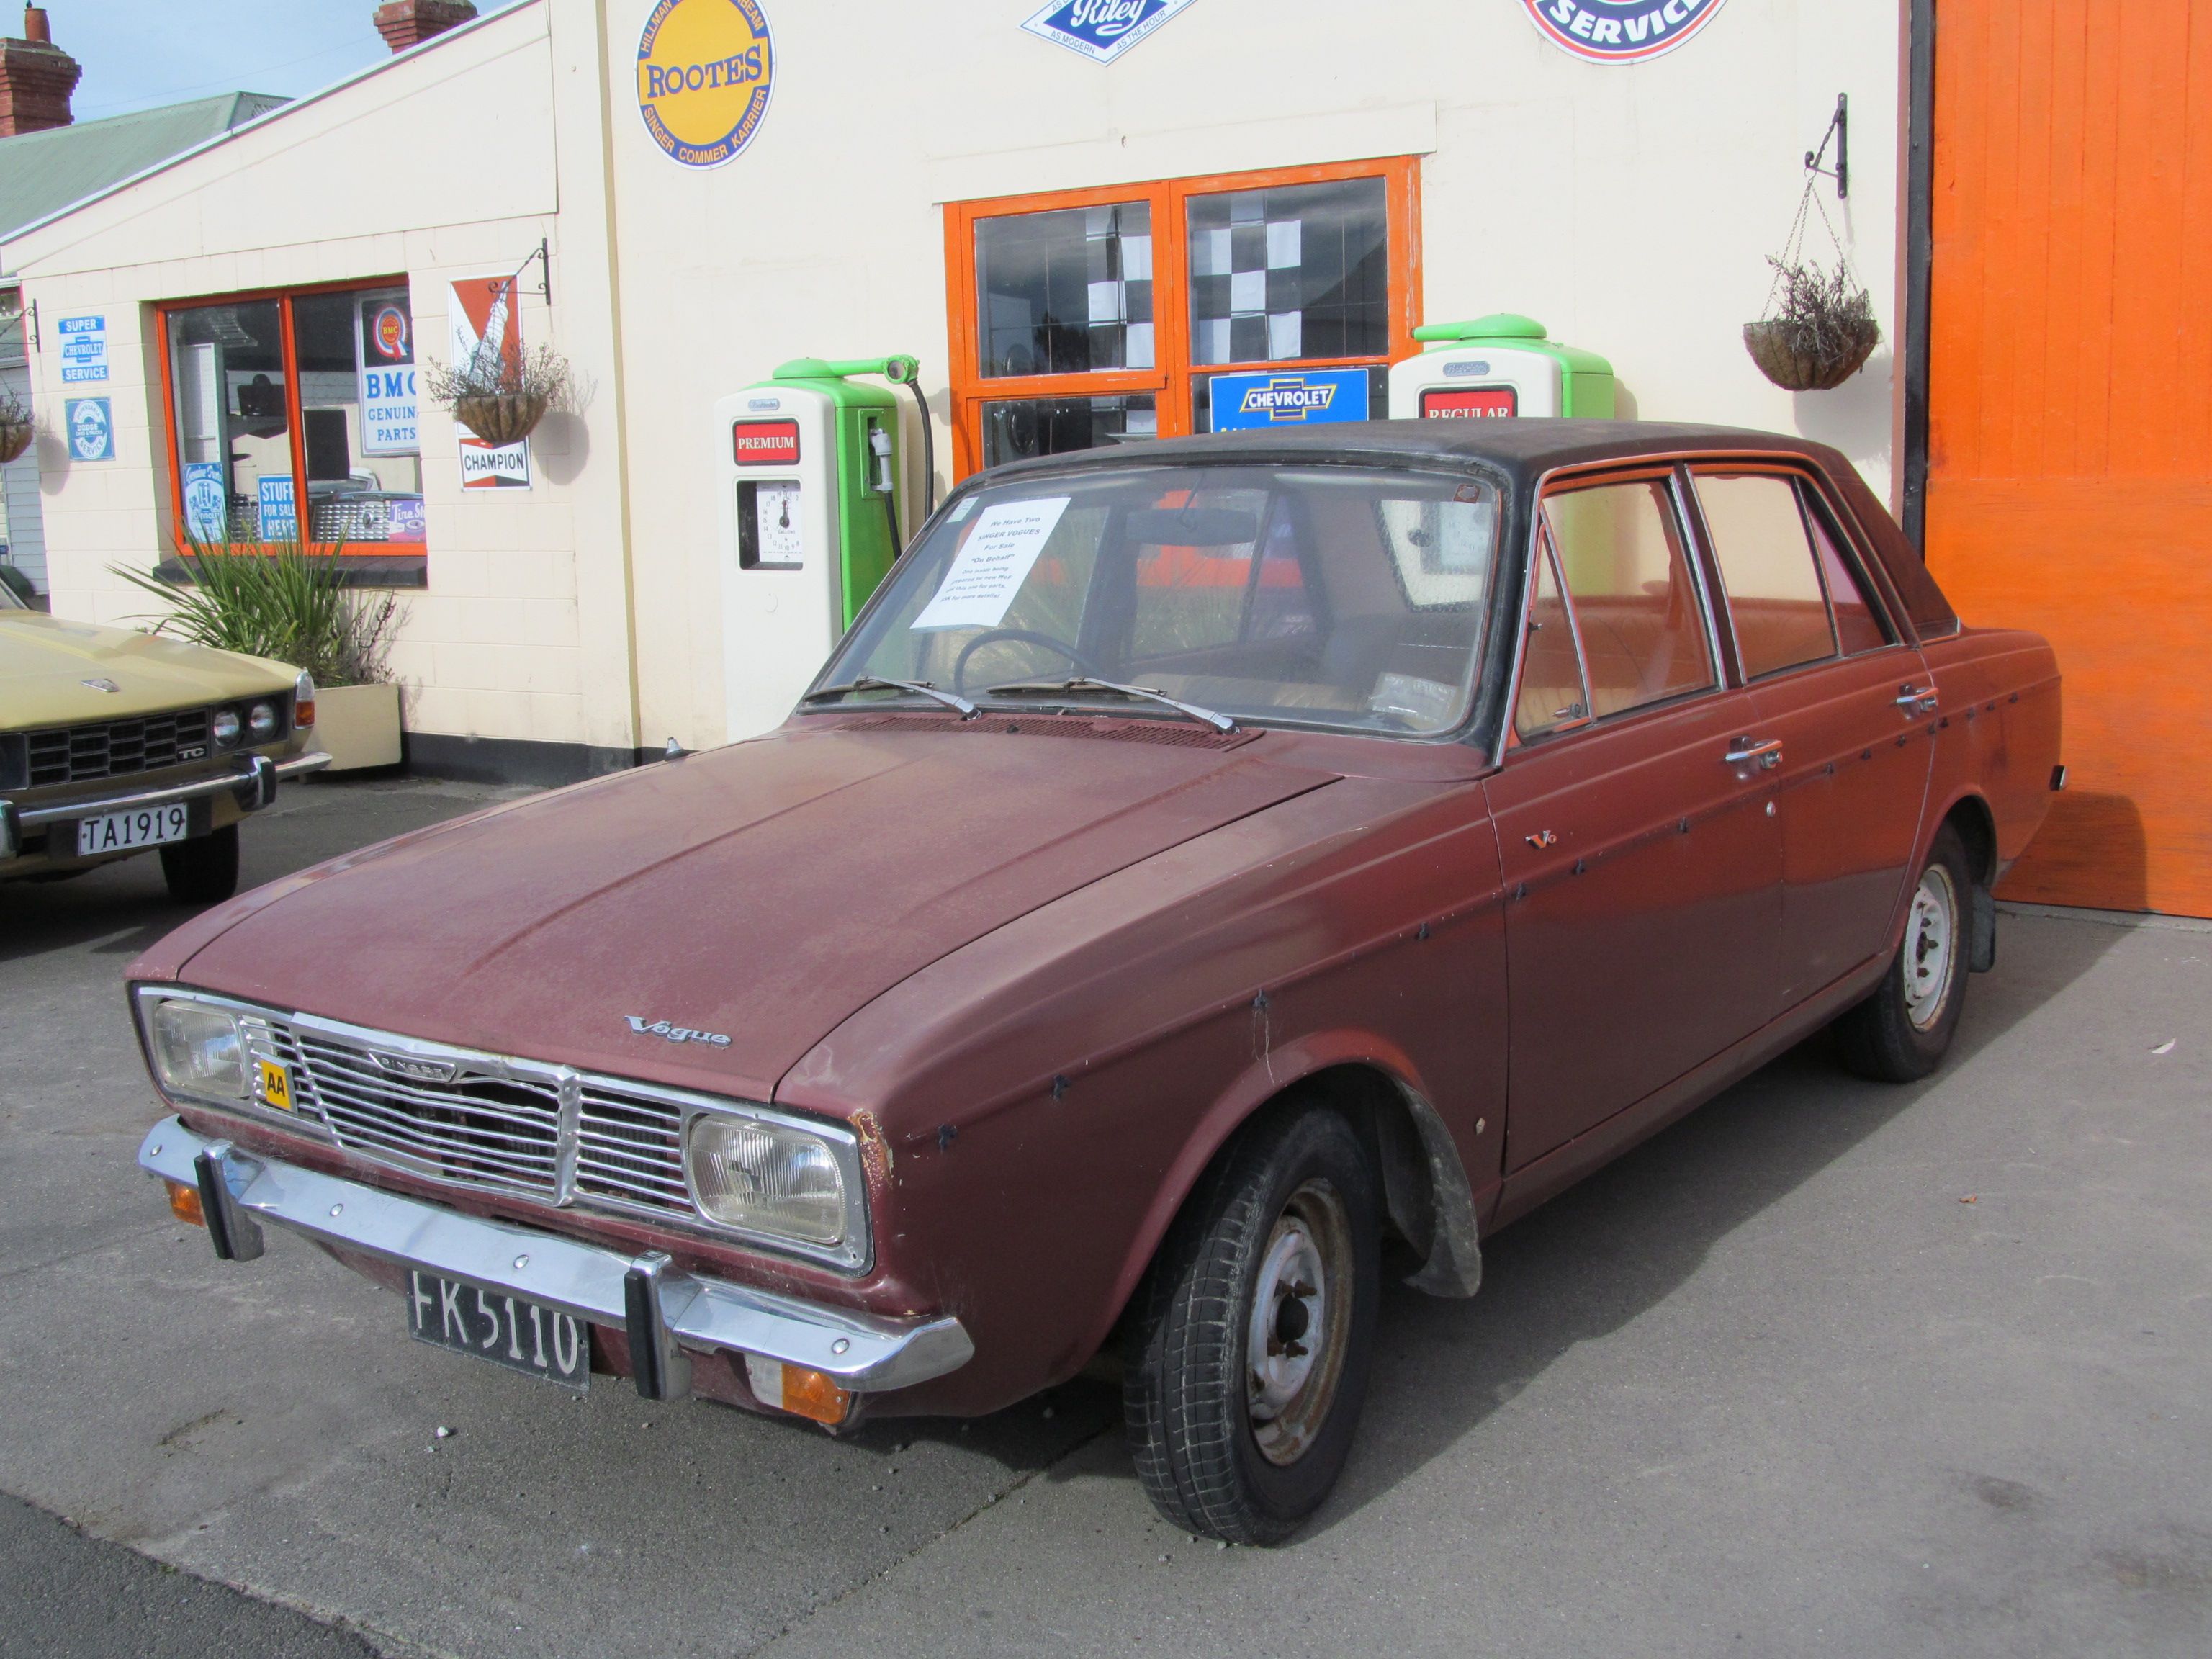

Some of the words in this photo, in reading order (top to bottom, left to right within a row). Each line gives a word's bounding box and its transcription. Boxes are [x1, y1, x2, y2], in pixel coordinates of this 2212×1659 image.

[1052, 1, 1062, 12] AS
[640, 0, 673, 53] HILLMAN
[1070, 0, 1147, 36] Riley
[1117, 40, 1127, 51] AS
[1128, 27, 1143, 42] THE
[1143, 9, 1166, 30] HOUR
[1051, 30, 1061, 40] AS
[1061, 35, 1095, 55] MODERN
[646, 44, 763, 99] ROOTES
[644, 107, 675, 153] SINGER
[678, 144, 728, 163] COMMER
[731, 89, 766, 148] KARRIER
[66, 318, 97, 331] SUPER
[383, 325, 398, 335] BMC
[65, 343, 102, 356] CHEVROLET
[66, 367, 107, 380] SERVICE
[1248, 390, 1329, 408] CHEVROLET
[368, 406, 417, 421] GENUIN
[377, 427, 415, 441] PARTS
[738, 436, 794, 449] PREMIUM
[464, 453, 524, 471] CHAMPION
[264, 504, 277, 517] FOR
[391, 503, 415, 525] Tire
[977, 531, 1006, 541] SINGER
[179, 747, 205, 759] TC
[85, 808, 183, 850] TA1919
[624, 1015, 733, 1046] Vogue
[266, 1071, 285, 1097] AA
[413, 1270, 577, 1375] FK5110
